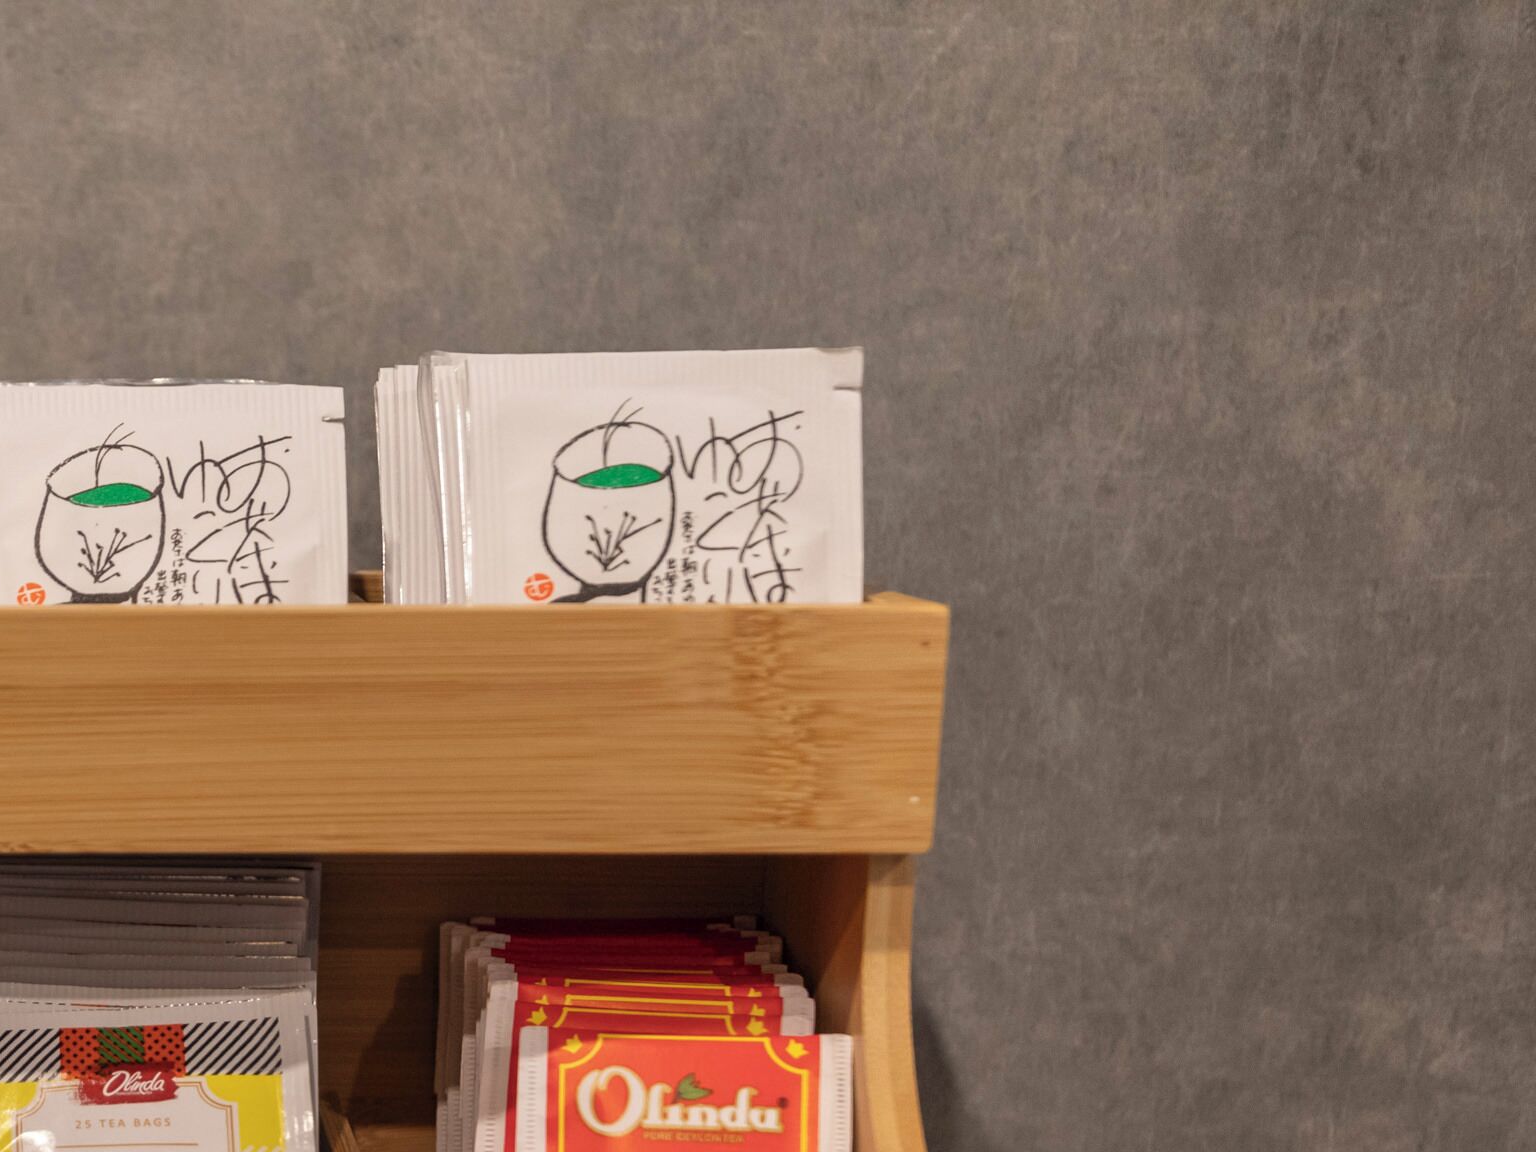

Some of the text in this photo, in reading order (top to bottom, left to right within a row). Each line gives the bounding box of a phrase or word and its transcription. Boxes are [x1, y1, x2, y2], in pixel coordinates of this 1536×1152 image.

[102, 1070, 165, 1097] Olinda
[576, 1065, 783, 1137] Olinda
[75, 1117, 172, 1130] 25 TEA BAGS
